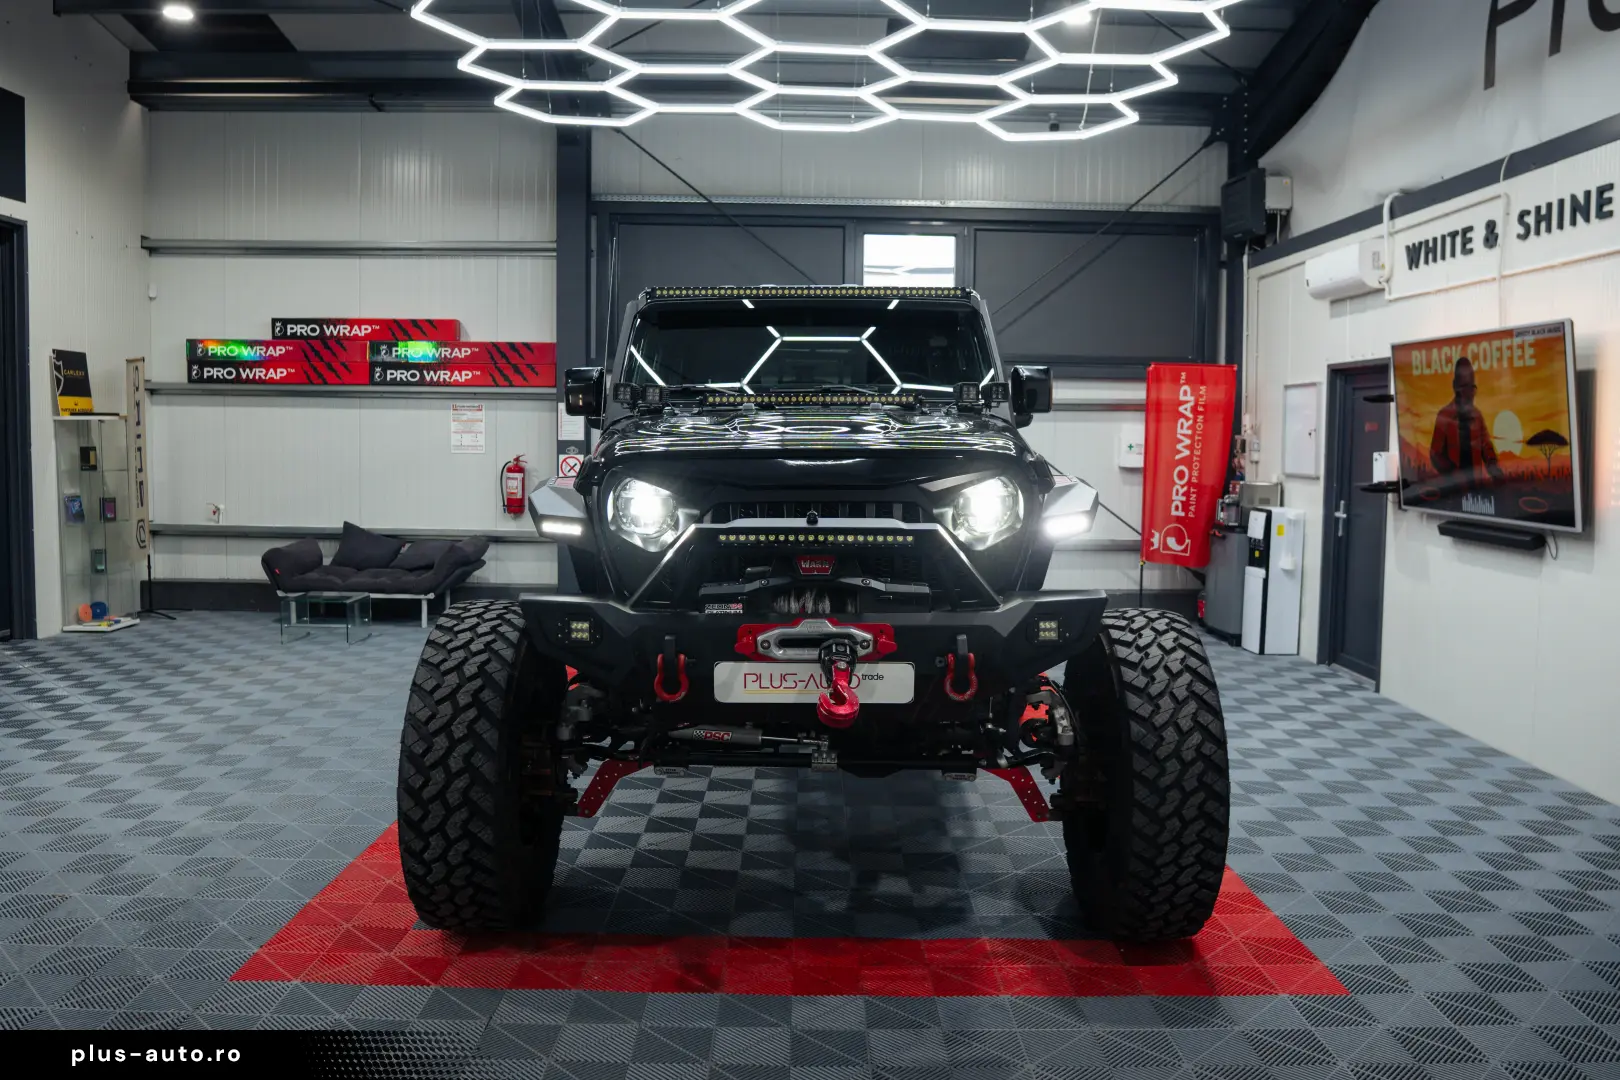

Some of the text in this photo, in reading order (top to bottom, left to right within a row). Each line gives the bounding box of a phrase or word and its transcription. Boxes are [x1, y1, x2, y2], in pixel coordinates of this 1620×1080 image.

[1405, 183, 1614, 271] WHITE & SHINE
[286, 324, 320, 336] PRO
[208, 346, 238, 357] PRO
[392, 347, 423, 358] PRO
[1411, 337, 1537, 376] BLACK COFFEE
[203, 367, 236, 379] PRO
[386, 370, 420, 382] PRO
[1188, 385, 1207, 518] PAINT PROTECTION FILM
[1171, 465, 1189, 517] PRO
[743, 673, 884, 689] PLUS-AUO trade
[704, 730, 731, 742] PSC
